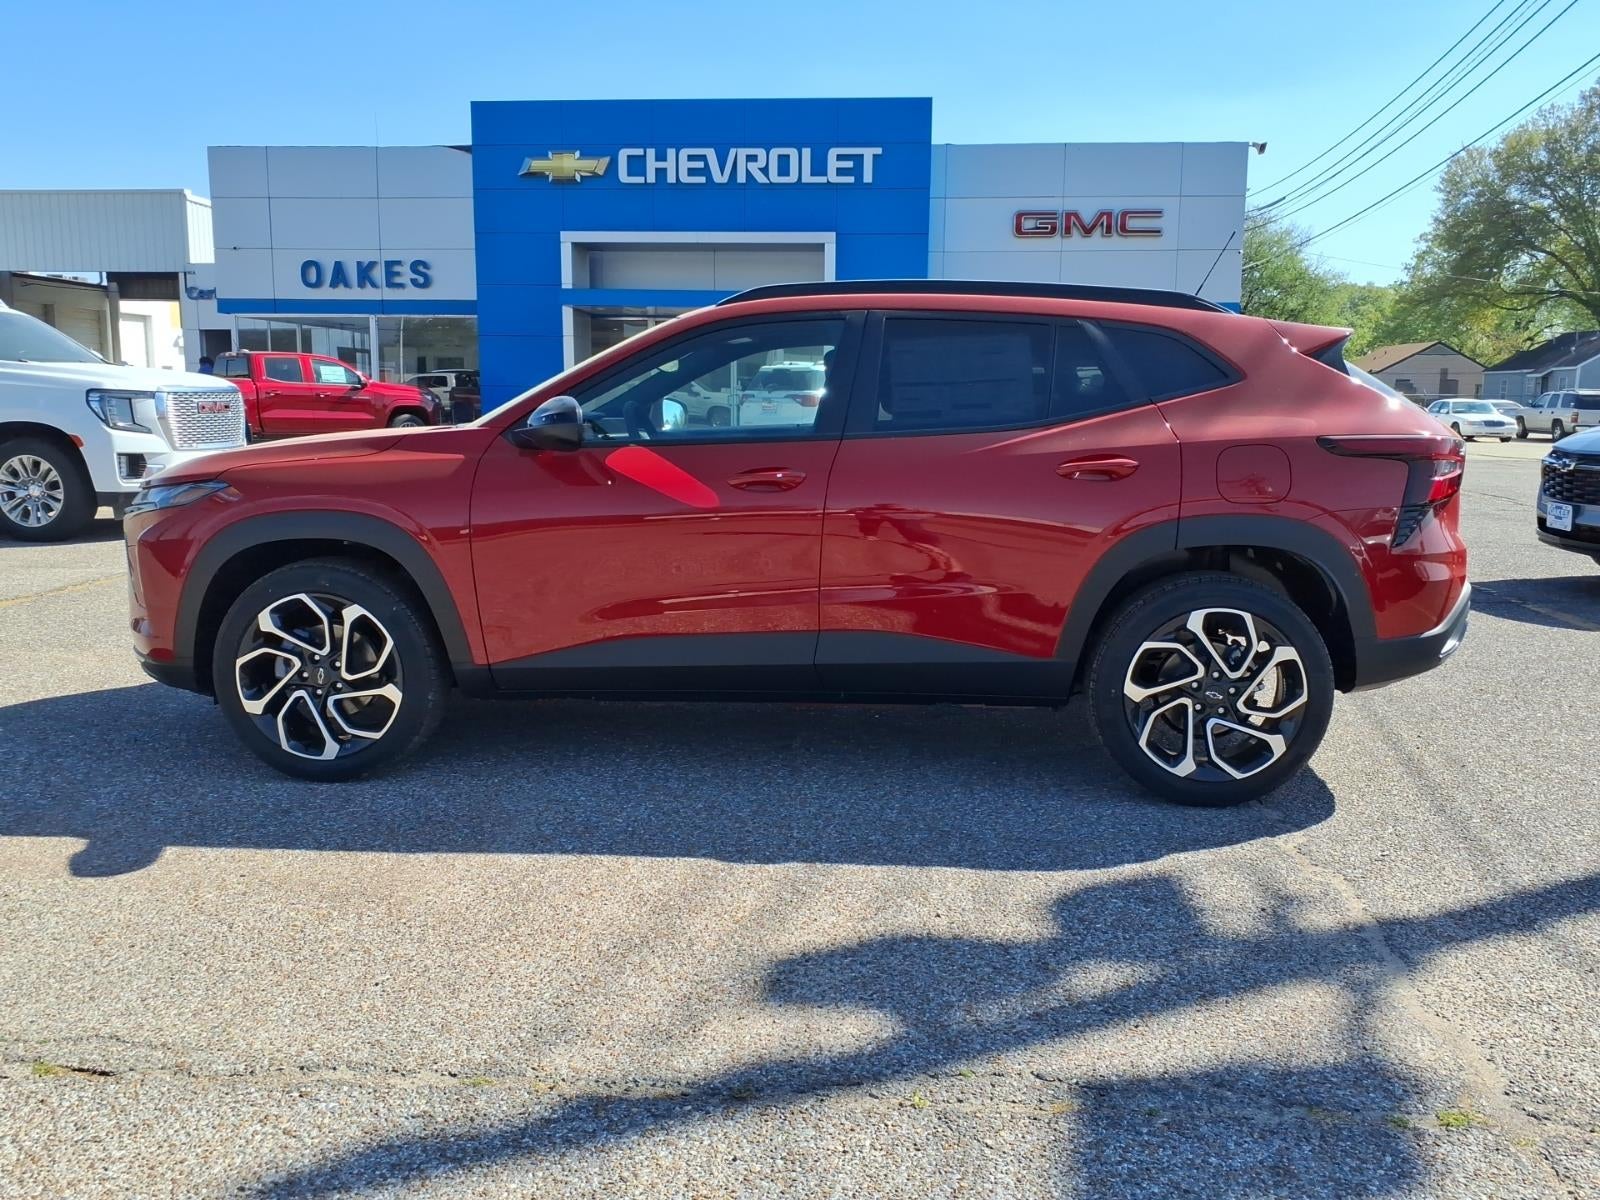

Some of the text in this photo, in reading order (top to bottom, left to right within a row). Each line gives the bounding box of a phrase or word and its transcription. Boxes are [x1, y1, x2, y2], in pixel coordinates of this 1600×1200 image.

[617, 147, 883, 184] CHEVROLET
[1013, 209, 1164, 237] GMC
[300, 259, 433, 289] OAKES
